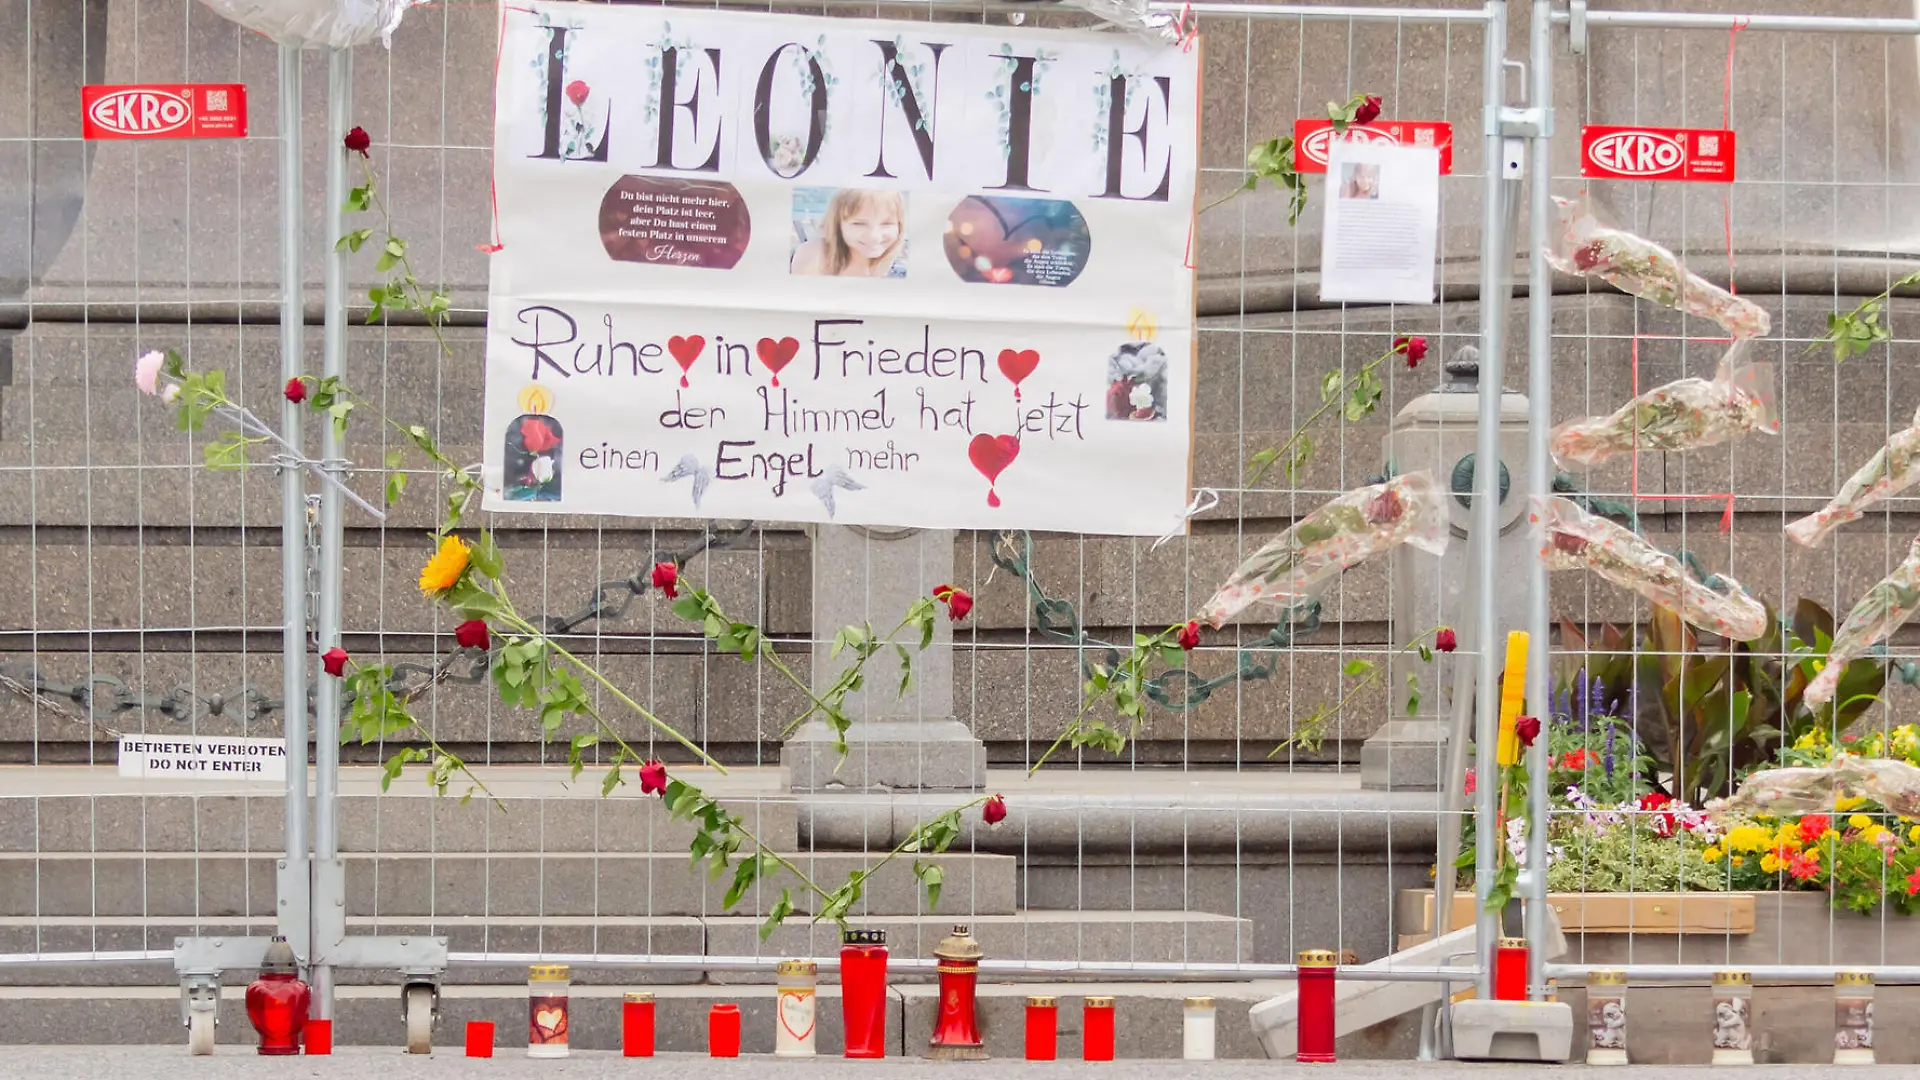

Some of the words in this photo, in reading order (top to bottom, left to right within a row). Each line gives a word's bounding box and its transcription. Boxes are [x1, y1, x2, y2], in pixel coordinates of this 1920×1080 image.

[95, 94, 184, 130] EKRO
[526, 25, 1171, 202] LEONIE
[1595, 136, 1678, 171] EKRO
[620, 190, 634, 200] Du
[635, 191, 653, 202] bist
[656, 193, 679, 203] nicht
[682, 195, 707, 206] mehr
[708, 197, 730, 208] hier,
[633, 204, 653, 214] dein
[656, 205, 679, 216] Platz
[681, 206, 693, 217] ist
[695, 208, 716, 220] leer,
[630, 216, 652, 226] aber
[653, 217, 667, 227] Du
[669, 218, 689, 229] hast
[691, 221, 716, 231] einen
[618, 227, 647, 238] festen
[649, 229, 673, 240] Platz
[675, 231, 685, 241] in
[686, 234, 727, 244] unserem
[645, 244, 700, 265] Herzen
[511, 306, 663, 380] Ruhe
[715, 335, 752, 377] in
[811, 318, 988, 383] Frieden
[659, 389, 726, 429] der
[757, 385, 895, 437] Himmel
[915, 386, 976, 435] hat
[1008, 392, 1089, 447] jetzt
[579, 442, 659, 472] einen
[715, 440, 823, 497] Engel
[846, 440, 919, 472] mehr
[124, 741, 202, 754] BETRETEN
[208, 744, 286, 756] VERBOTEN
[150, 759, 170, 769] DO
[176, 760, 207, 770] NOT
[213, 761, 261, 772] ENTER
